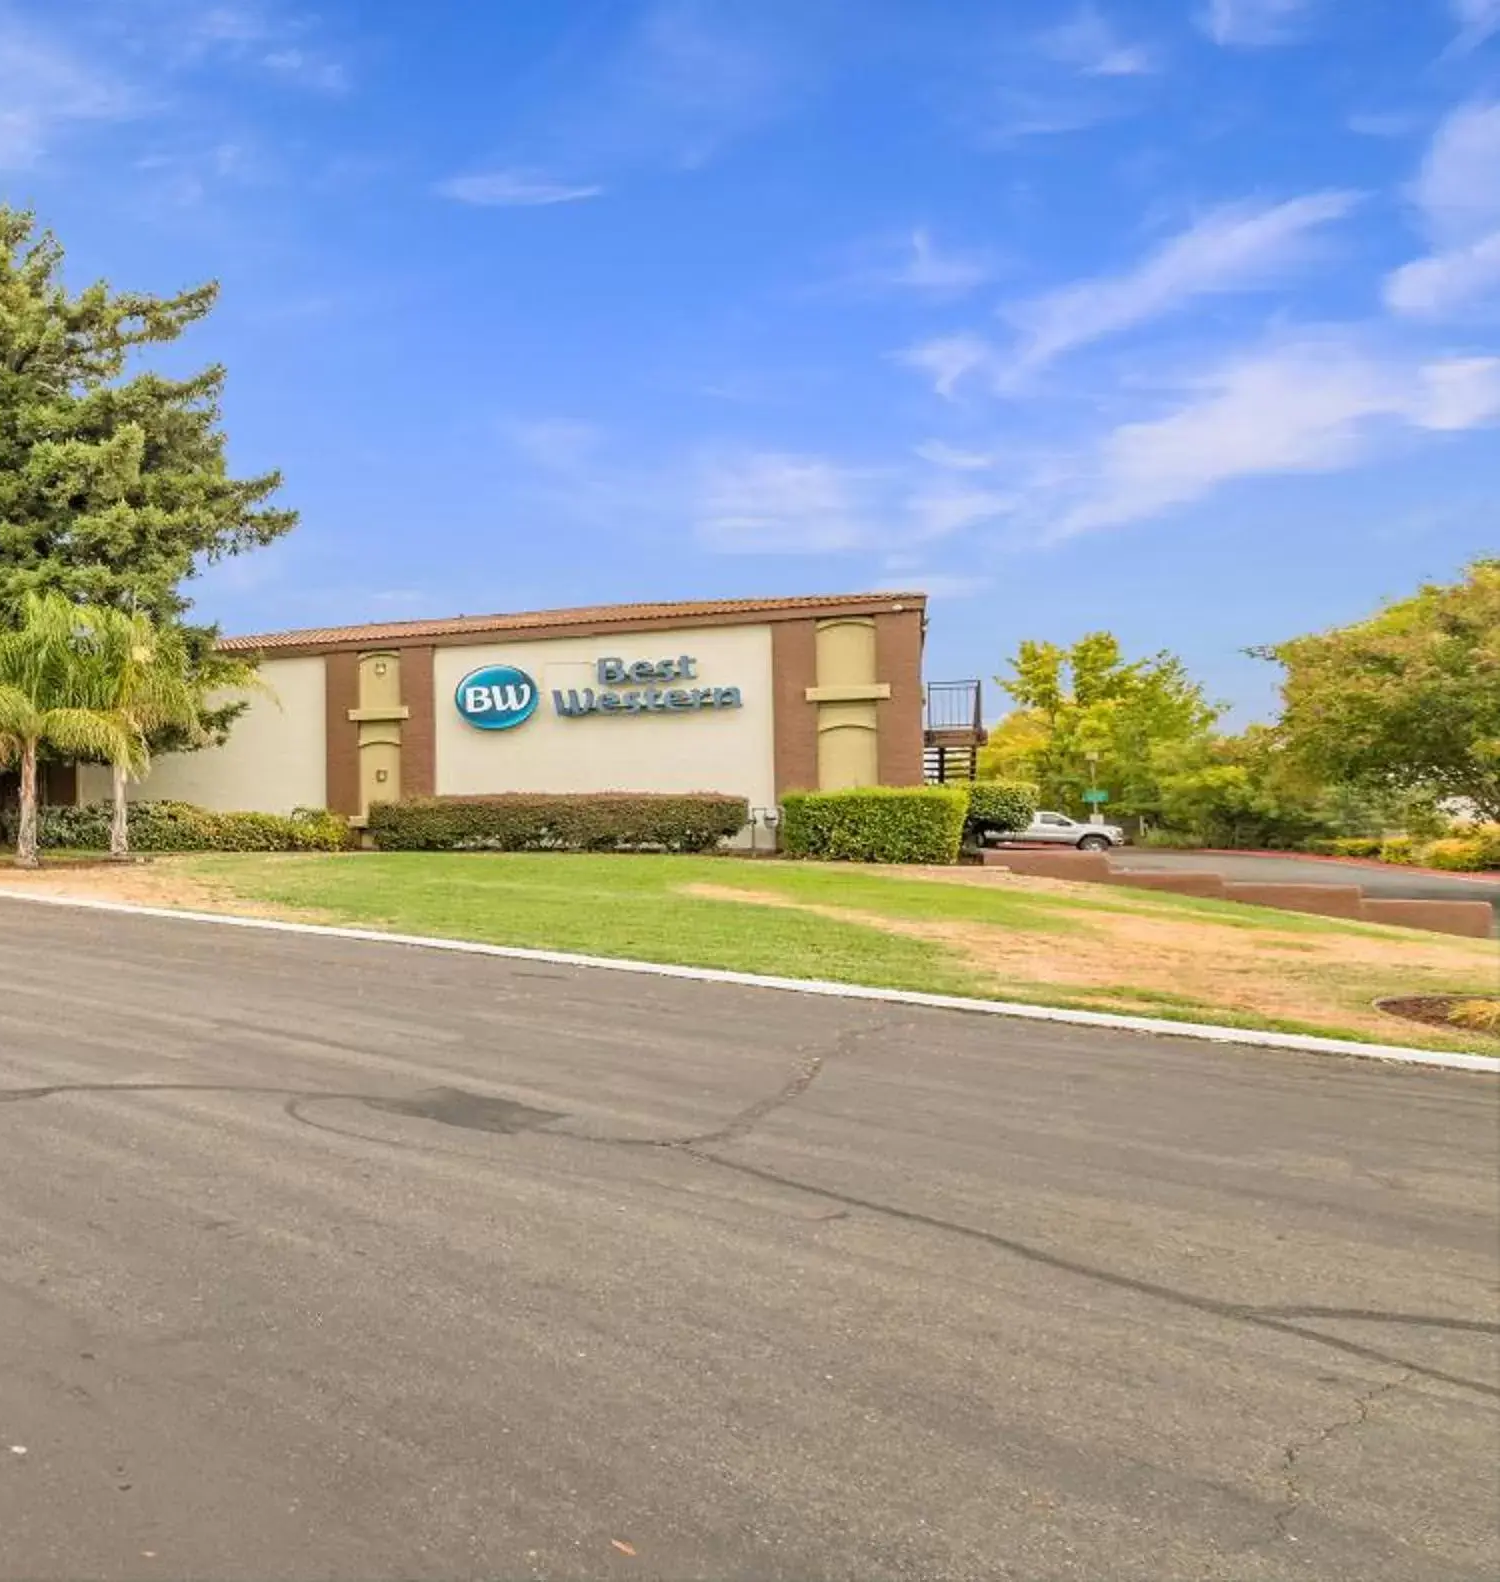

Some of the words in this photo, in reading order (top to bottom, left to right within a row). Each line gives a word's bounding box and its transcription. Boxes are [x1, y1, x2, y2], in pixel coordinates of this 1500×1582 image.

[595, 654, 698, 685] Best
[464, 684, 532, 714] BW
[551, 686, 743, 718] Western
